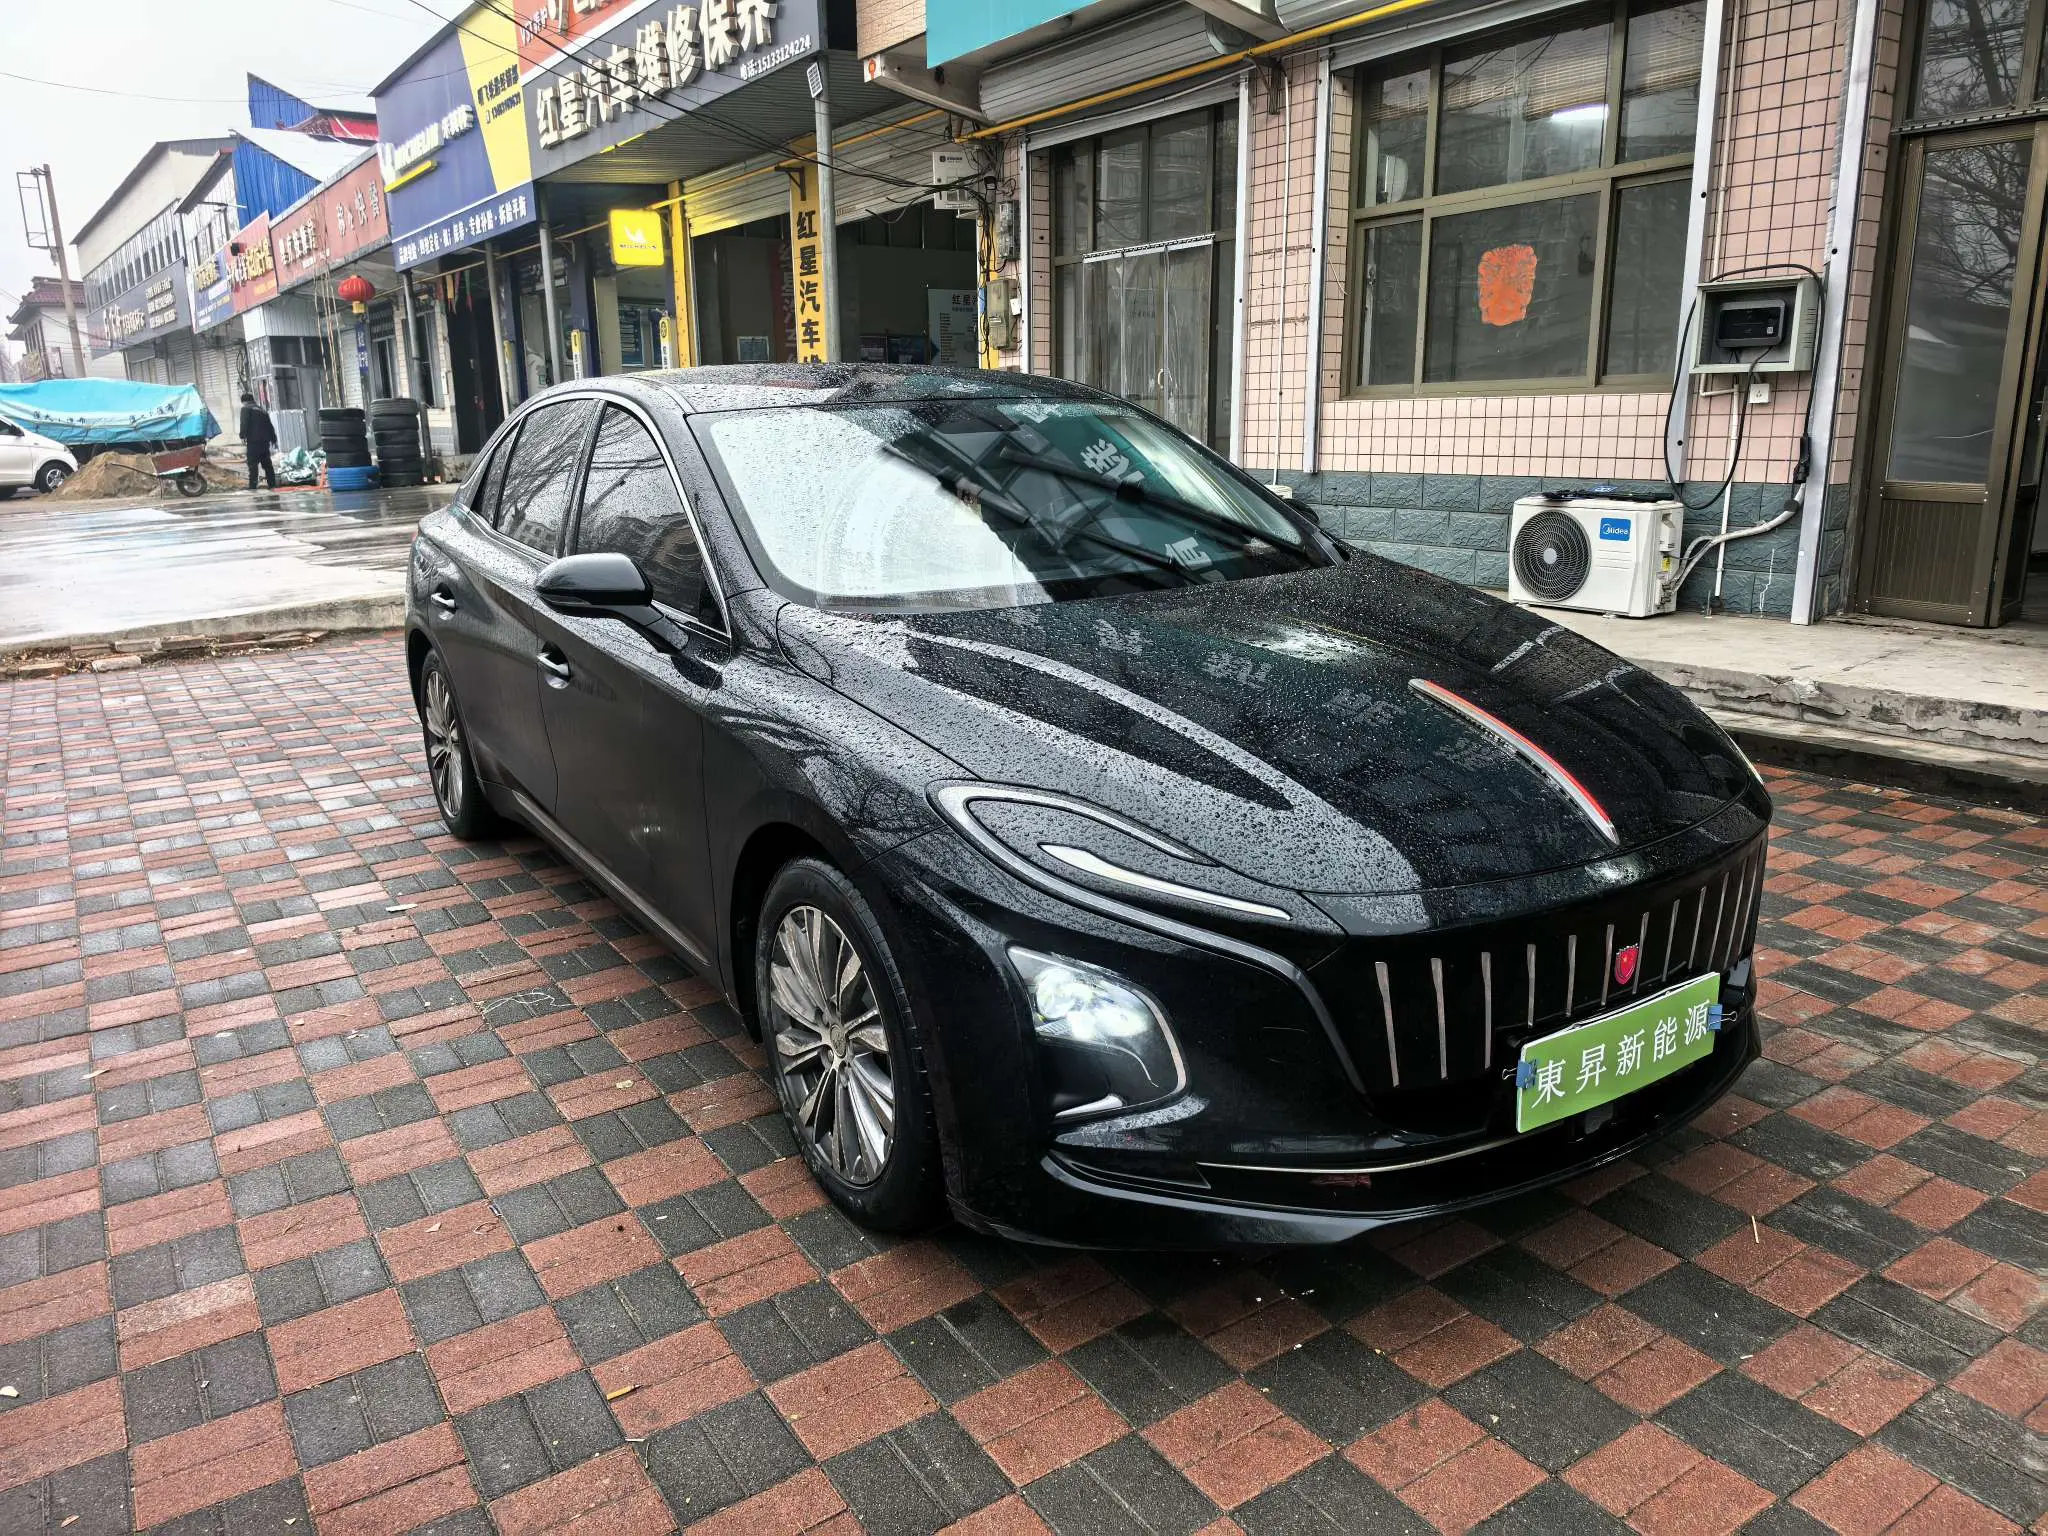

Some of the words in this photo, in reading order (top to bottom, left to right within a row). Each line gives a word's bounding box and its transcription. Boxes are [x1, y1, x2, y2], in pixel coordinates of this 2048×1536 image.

[796, 209, 823, 363] 红星汽车
[1601, 523, 1629, 535] Midea
[1531, 998, 1711, 1109] 東昇新能源
